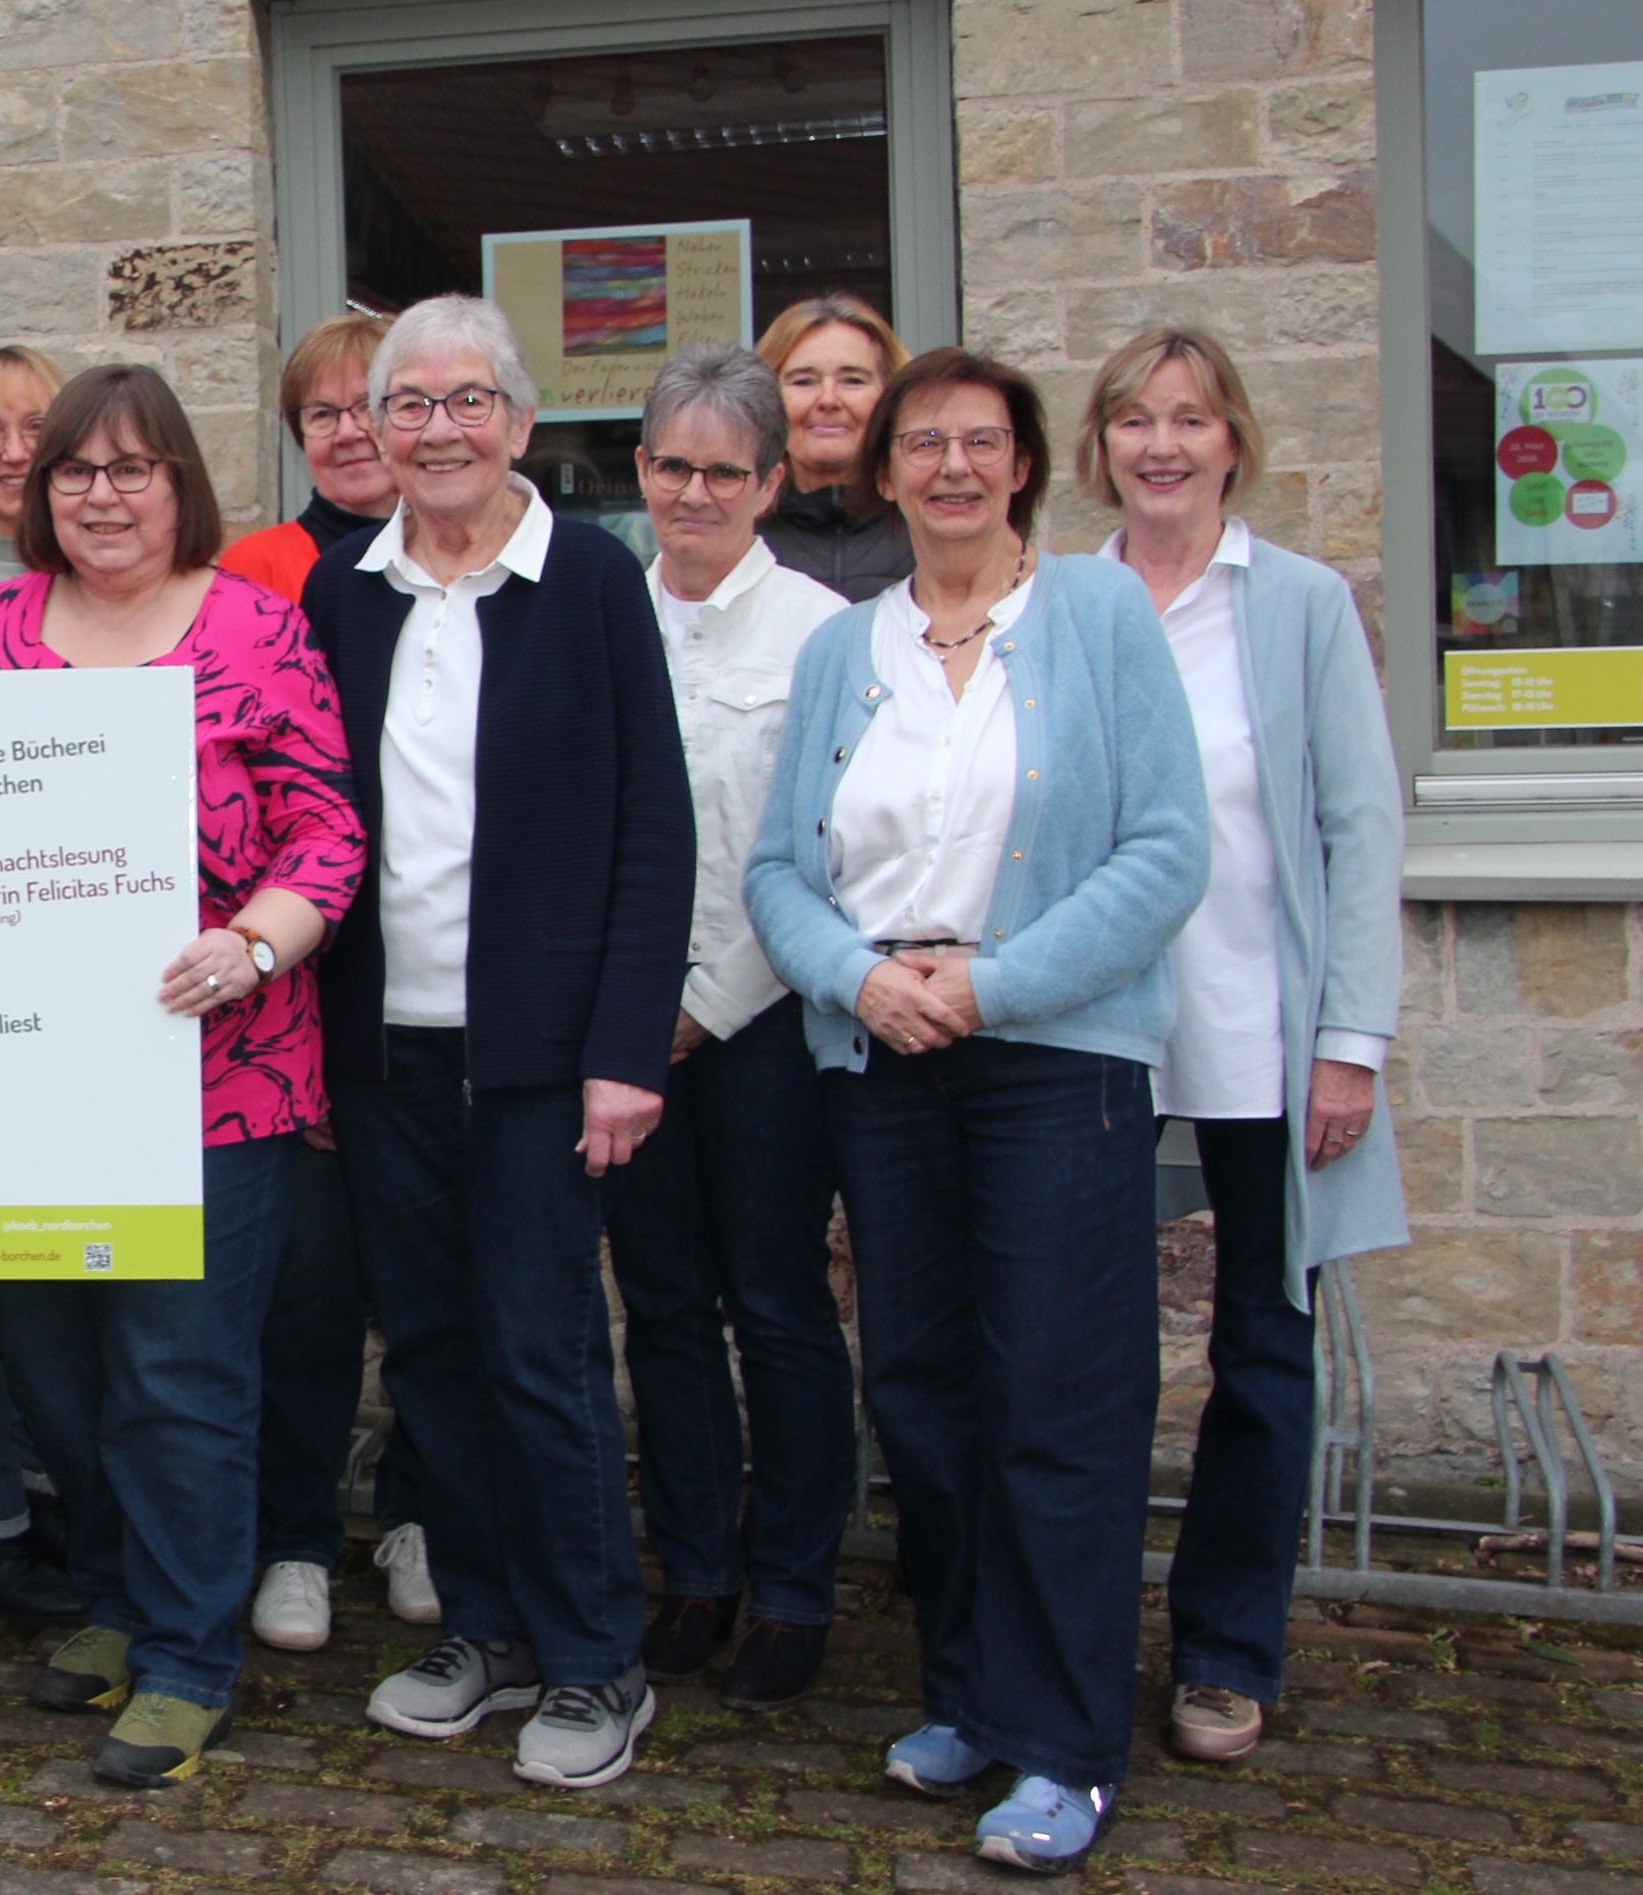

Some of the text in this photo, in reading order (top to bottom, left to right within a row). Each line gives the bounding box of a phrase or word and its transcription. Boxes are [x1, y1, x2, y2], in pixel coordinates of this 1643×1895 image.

[561, 376, 656, 405] verliere
[12, 733, 106, 762] Bücherei
[26, 876, 109, 903] Felicitas
[115, 869, 176, 896] Fuchs
